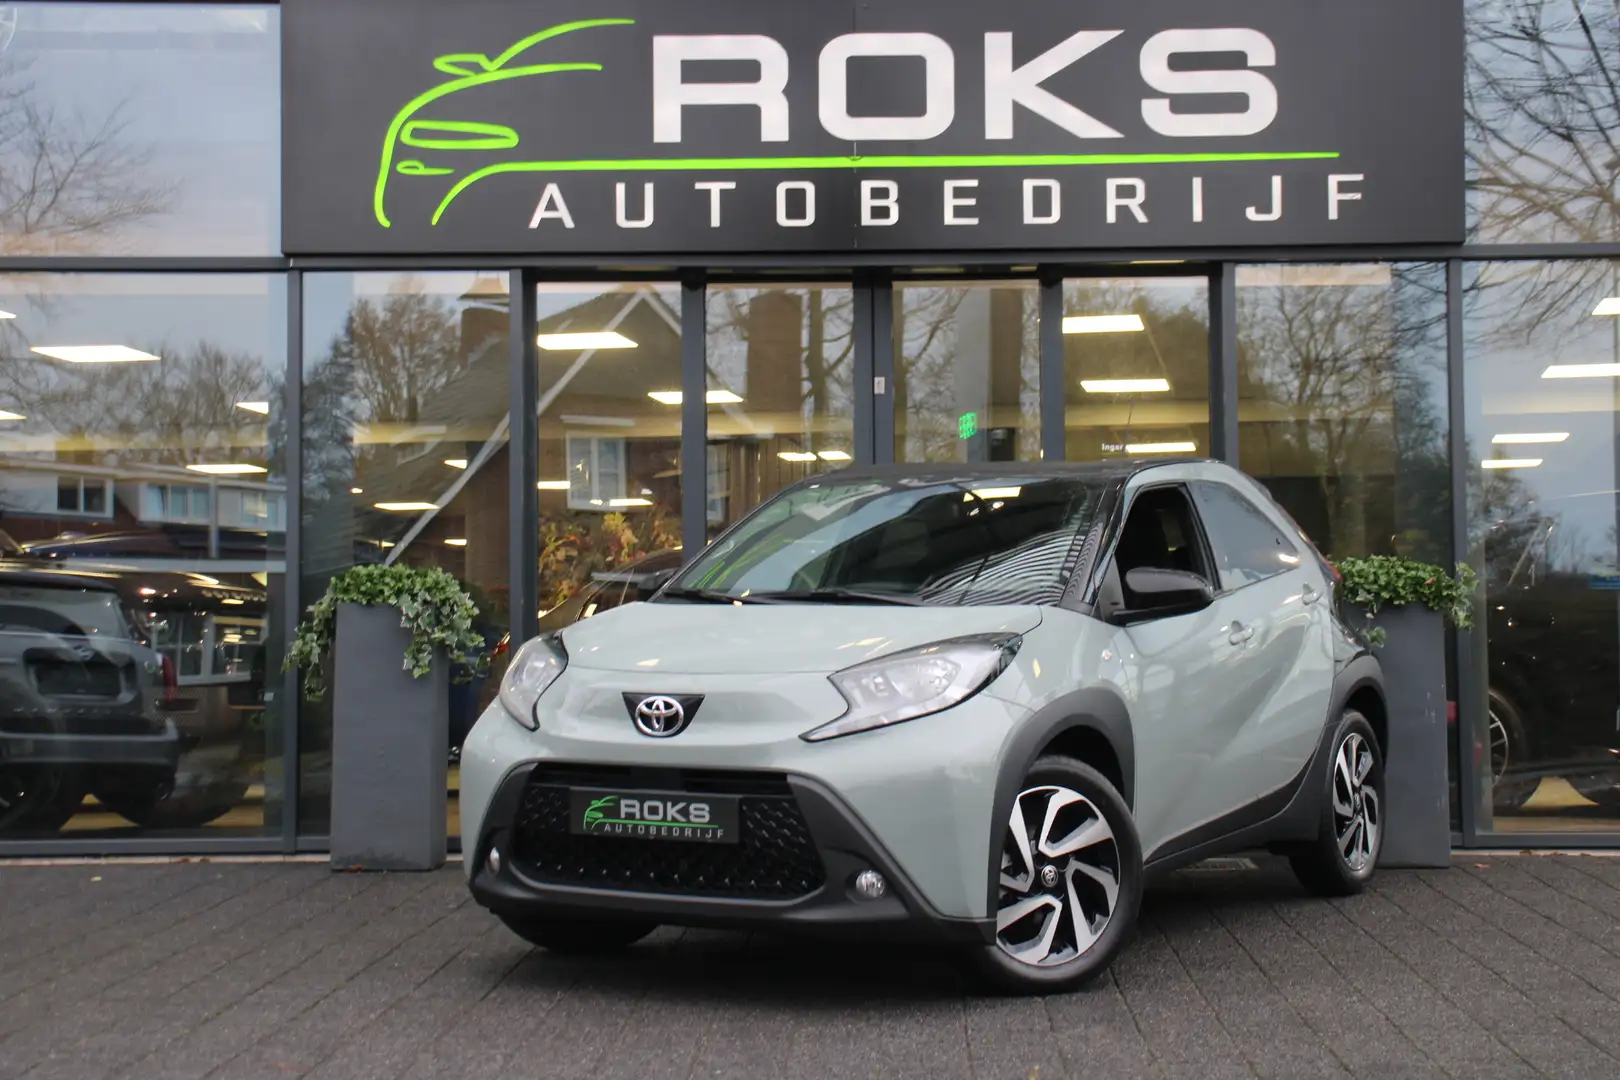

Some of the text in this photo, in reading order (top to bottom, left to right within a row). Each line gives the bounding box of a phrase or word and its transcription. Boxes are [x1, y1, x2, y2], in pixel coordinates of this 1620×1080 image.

[653, 28, 1278, 143] ROKS
[528, 173, 1364, 229] AUTOBEDRIJF
[603, 823, 724, 839] AUTOBEDRIJF
[620, 798, 711, 824] ROKS
